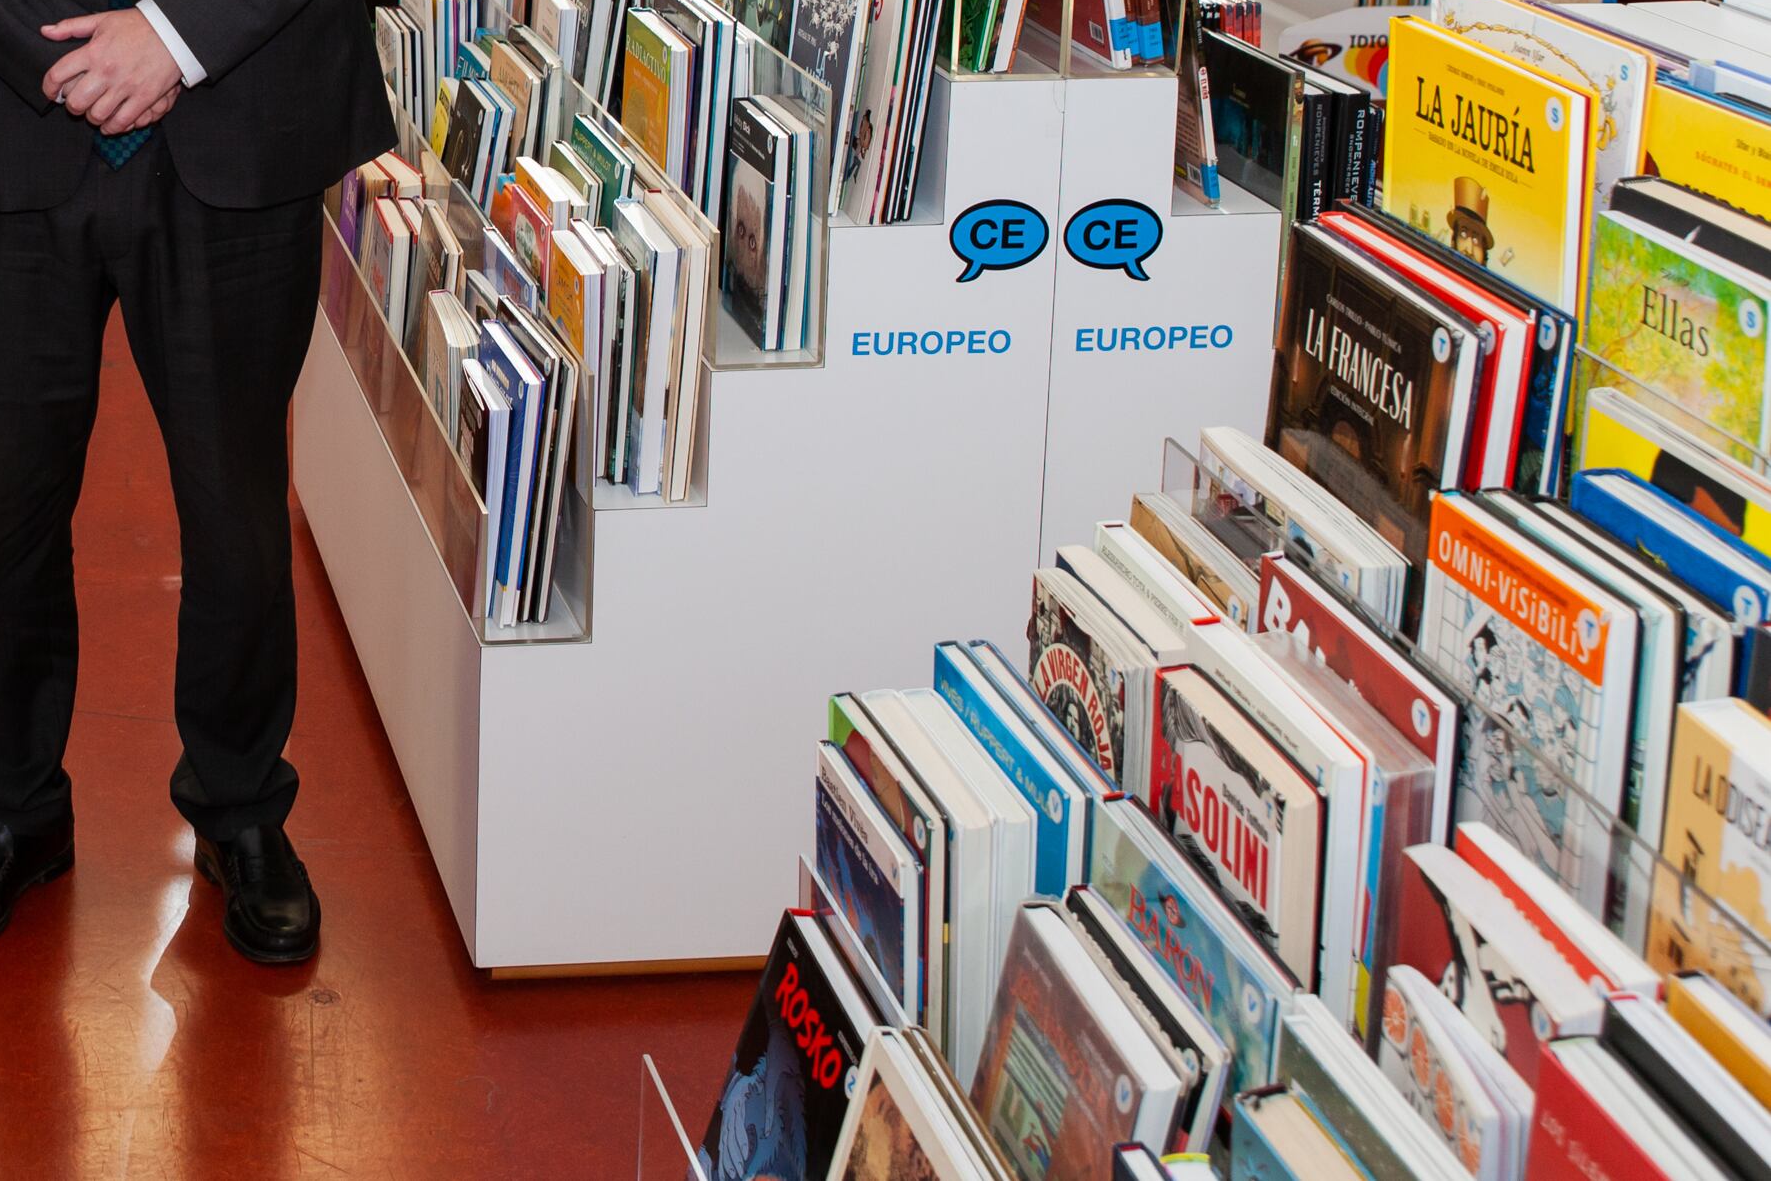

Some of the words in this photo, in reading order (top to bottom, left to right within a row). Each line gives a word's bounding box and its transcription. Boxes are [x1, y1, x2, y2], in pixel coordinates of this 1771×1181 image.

[626, 35, 666, 84] RADIACTIVO
[1349, 35, 1388, 50] IDIO
[742, 121, 752, 136] Dick
[1416, 76, 1444, 127] LA
[1451, 94, 1535, 173] JAURÍA
[970, 219, 1025, 249] CE
[1083, 220, 1138, 250] CE
[852, 330, 1011, 355] EUROPEO
[1075, 325, 1233, 351] EUROPEO
[1640, 286, 1710, 357] Ellas
[1305, 308, 1325, 363] LA
[1328, 326, 1413, 430] FRANCESA
[1035, 669, 1049, 700] LA
[1045, 643, 1089, 702] VIRGEN
[1087, 692, 1113, 771] ROJA
[1694, 755, 1712, 806] LA
[1155, 741, 1268, 911] PASOLINI
[775, 961, 842, 1089] ROSKO
